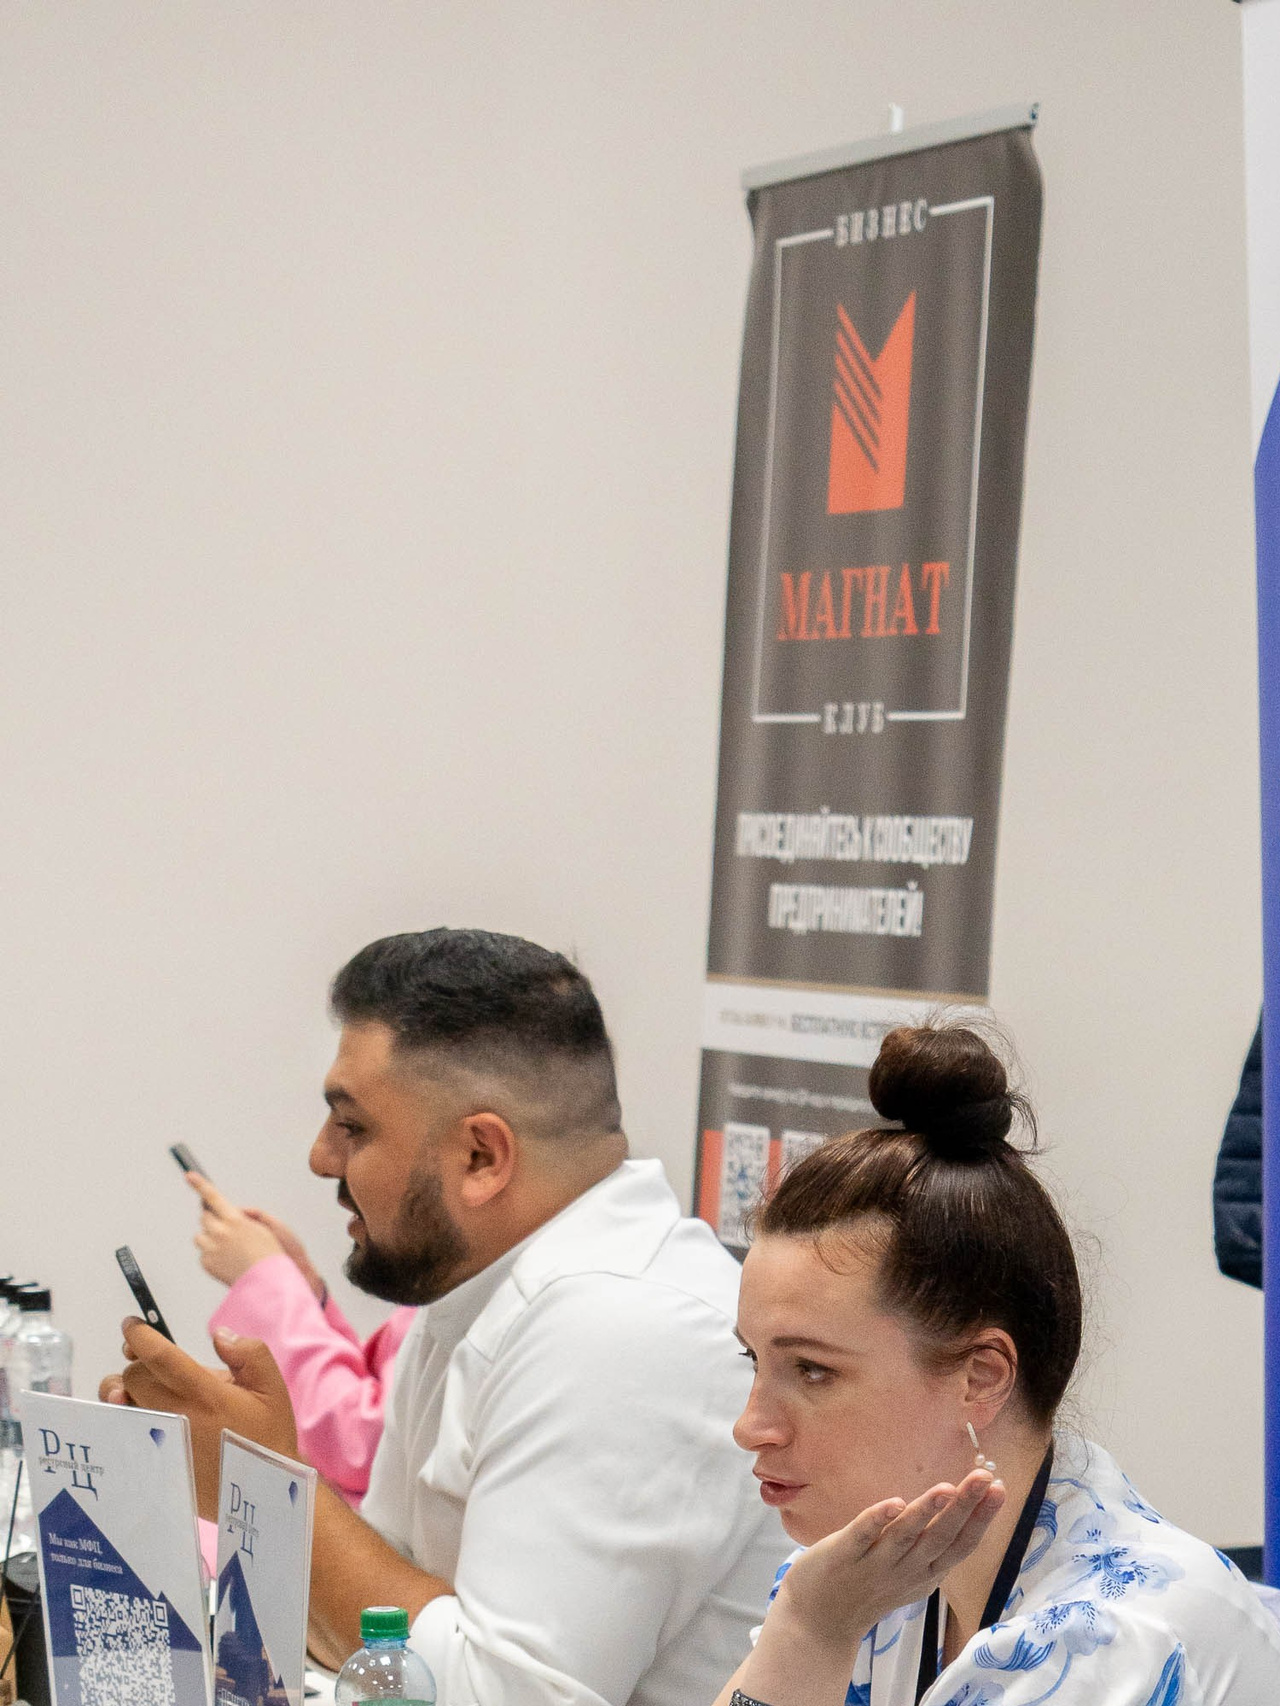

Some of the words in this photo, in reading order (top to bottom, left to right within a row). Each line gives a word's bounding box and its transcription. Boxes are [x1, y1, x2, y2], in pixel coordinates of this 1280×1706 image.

[835, 197, 928, 248] БИЗНЕС
[776, 562, 950, 642] МАГНАТ
[823, 702, 885, 734] КЛУБ
[38, 1427, 99, 1501] РЦ
[93, 1558, 124, 1575] бизнеса
